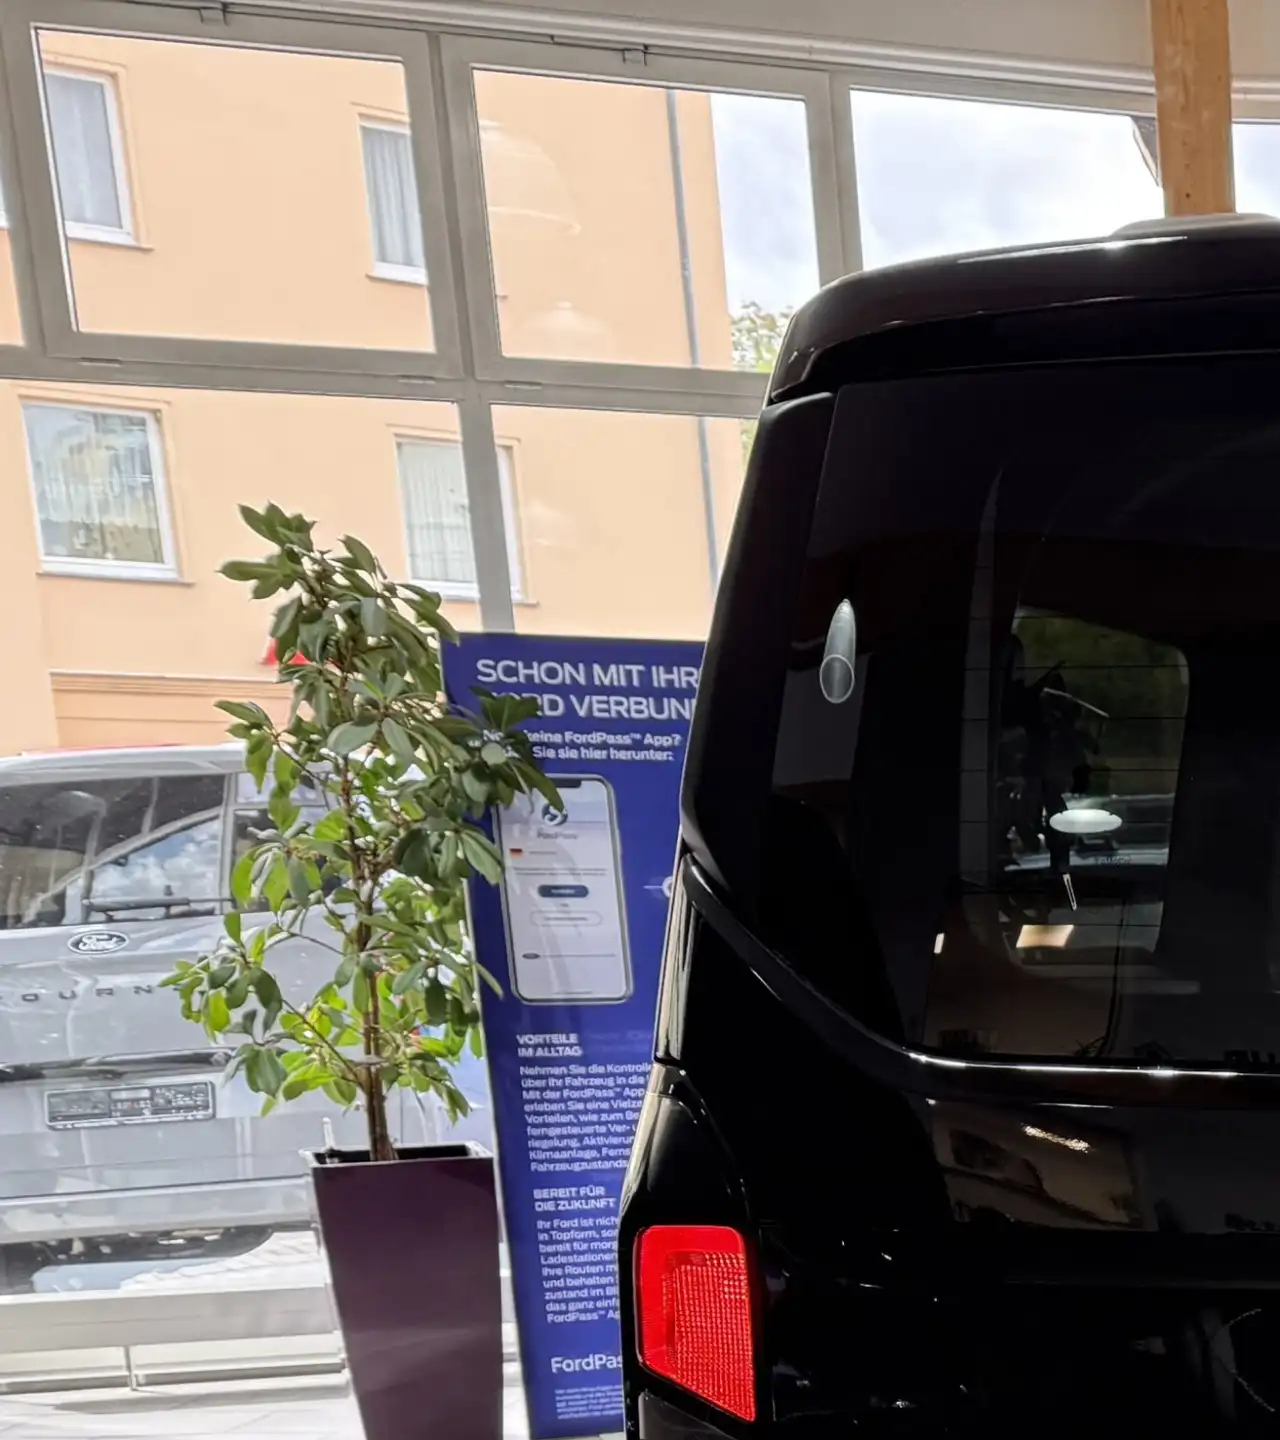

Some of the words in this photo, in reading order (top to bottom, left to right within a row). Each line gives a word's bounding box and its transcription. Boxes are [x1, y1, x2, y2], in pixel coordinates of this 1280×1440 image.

[476, 658, 587, 686] SCHON
[592, 663, 646, 688] MIT
[651, 665, 701, 689] IHR
[569, 694, 698, 721] VERBUN
[643, 733, 682, 748] App?
[532, 745, 556, 759] Sie
[557, 747, 580, 760] sie
[580, 746, 607, 761] hier
[609, 747, 674, 762] herunter:
[516, 1033, 579, 1045] VORTEILE
[535, 1046, 583, 1057] ALLTAG
[588, 1064, 605, 1074] die
[564, 1076, 615, 1087] Fahrzeug
[586, 1100, 610, 1110] eine
[578, 1112, 599, 1122] wie
[532, 1187, 578, 1200] BEREIT
[579, 1184, 606, 1198] FÜR
[534, 1200, 556, 1212] DIE
[557, 1197, 618, 1211] ZUKUNFT
[553, 1218, 579, 1229] Ford
